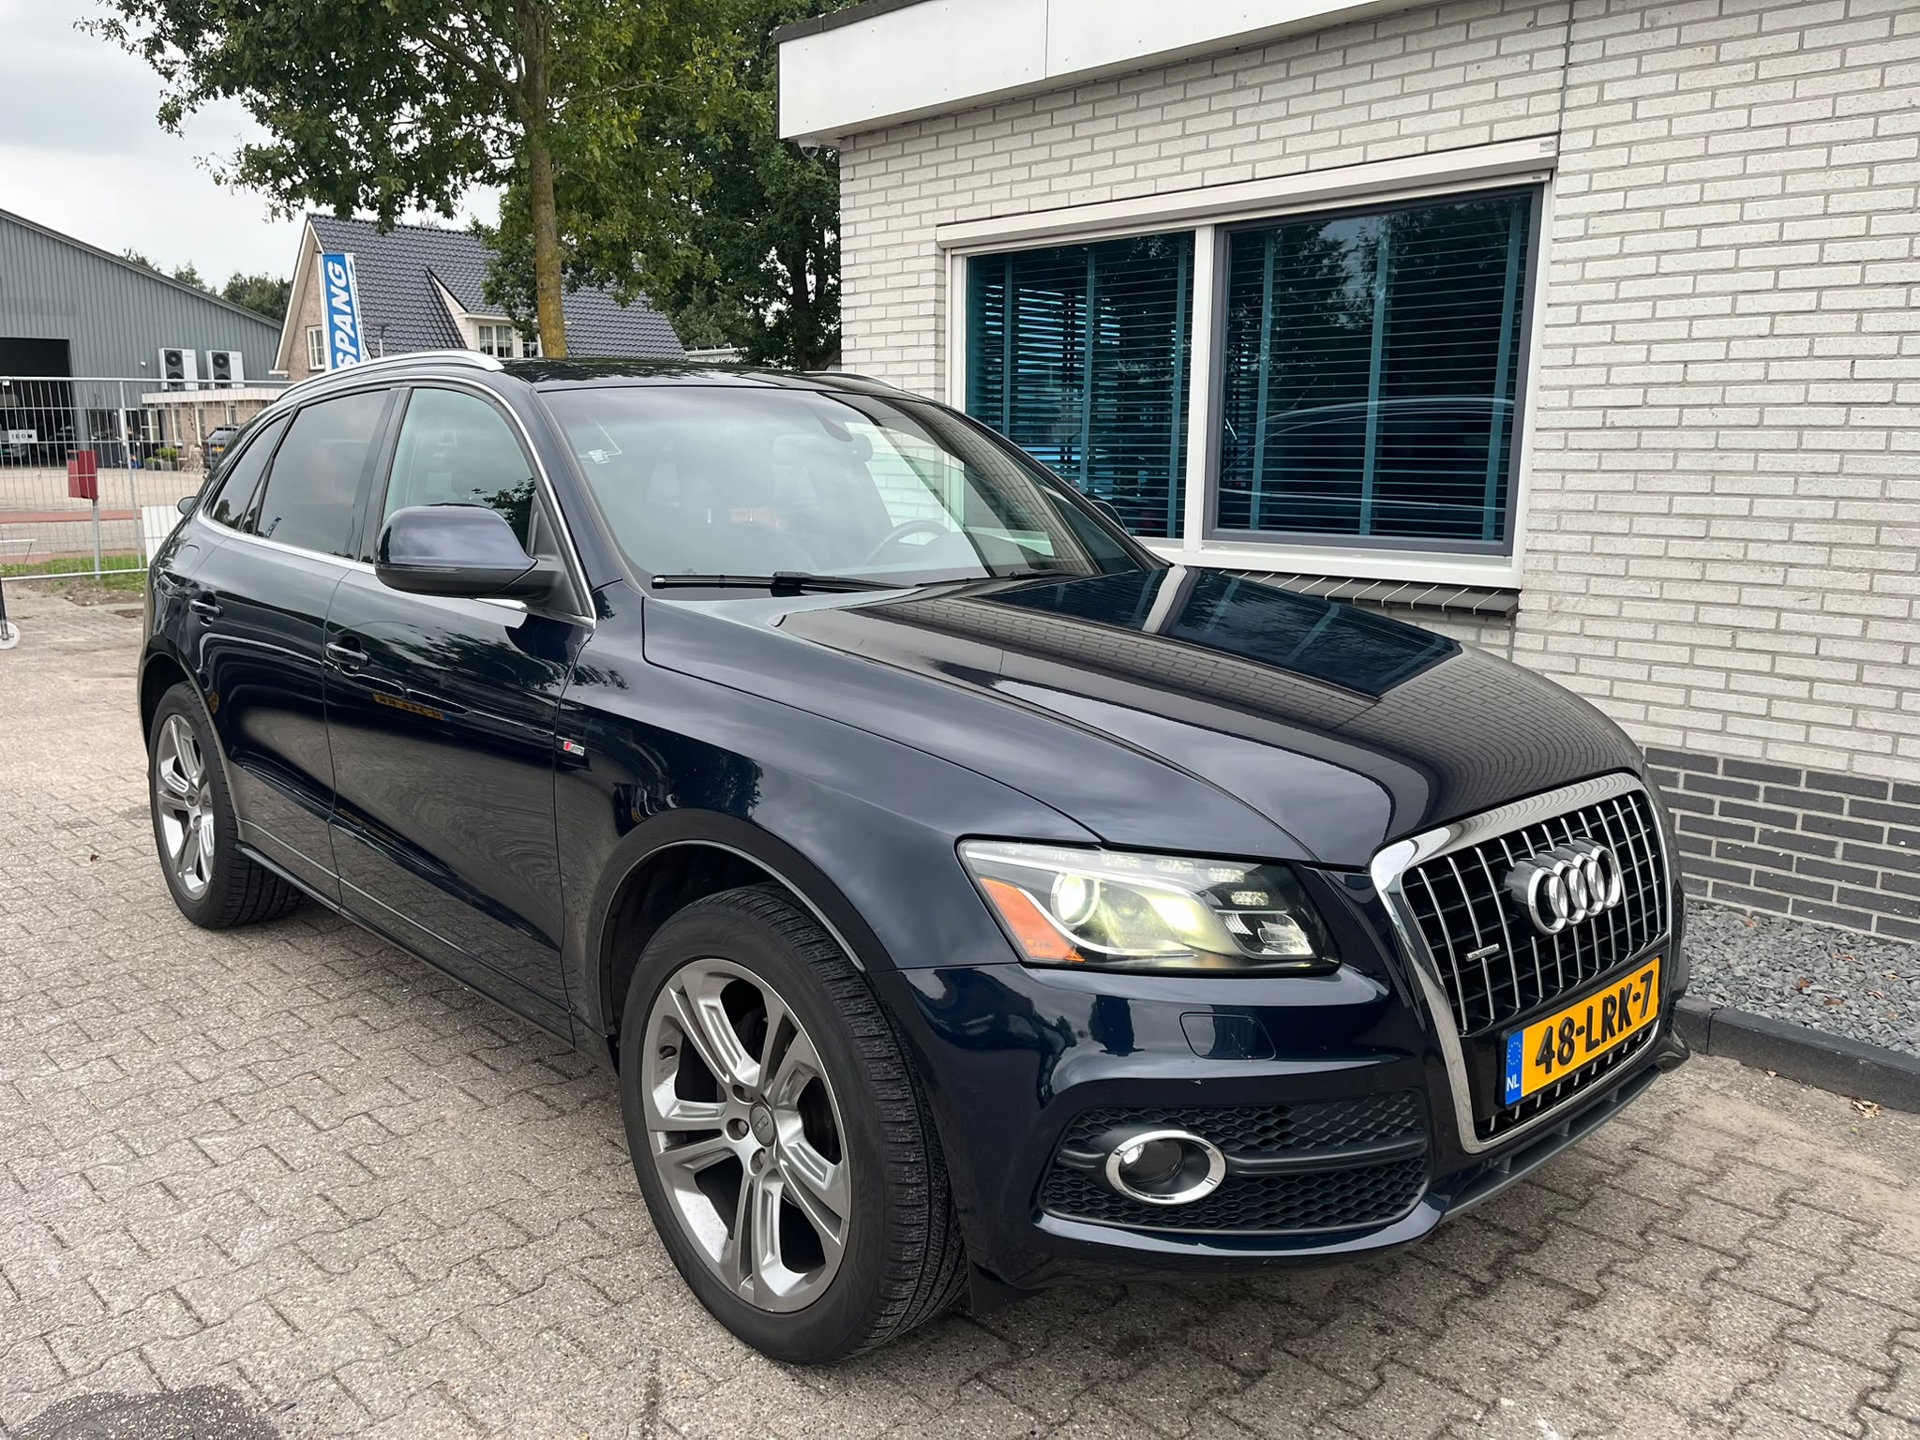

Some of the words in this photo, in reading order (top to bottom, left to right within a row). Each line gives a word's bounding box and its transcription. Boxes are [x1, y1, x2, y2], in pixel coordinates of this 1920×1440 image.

[327, 261, 359, 369] SPANG
[1535, 969, 1654, 1075] 48-LRK-7
[1506, 1073, 1520, 1092] NL
